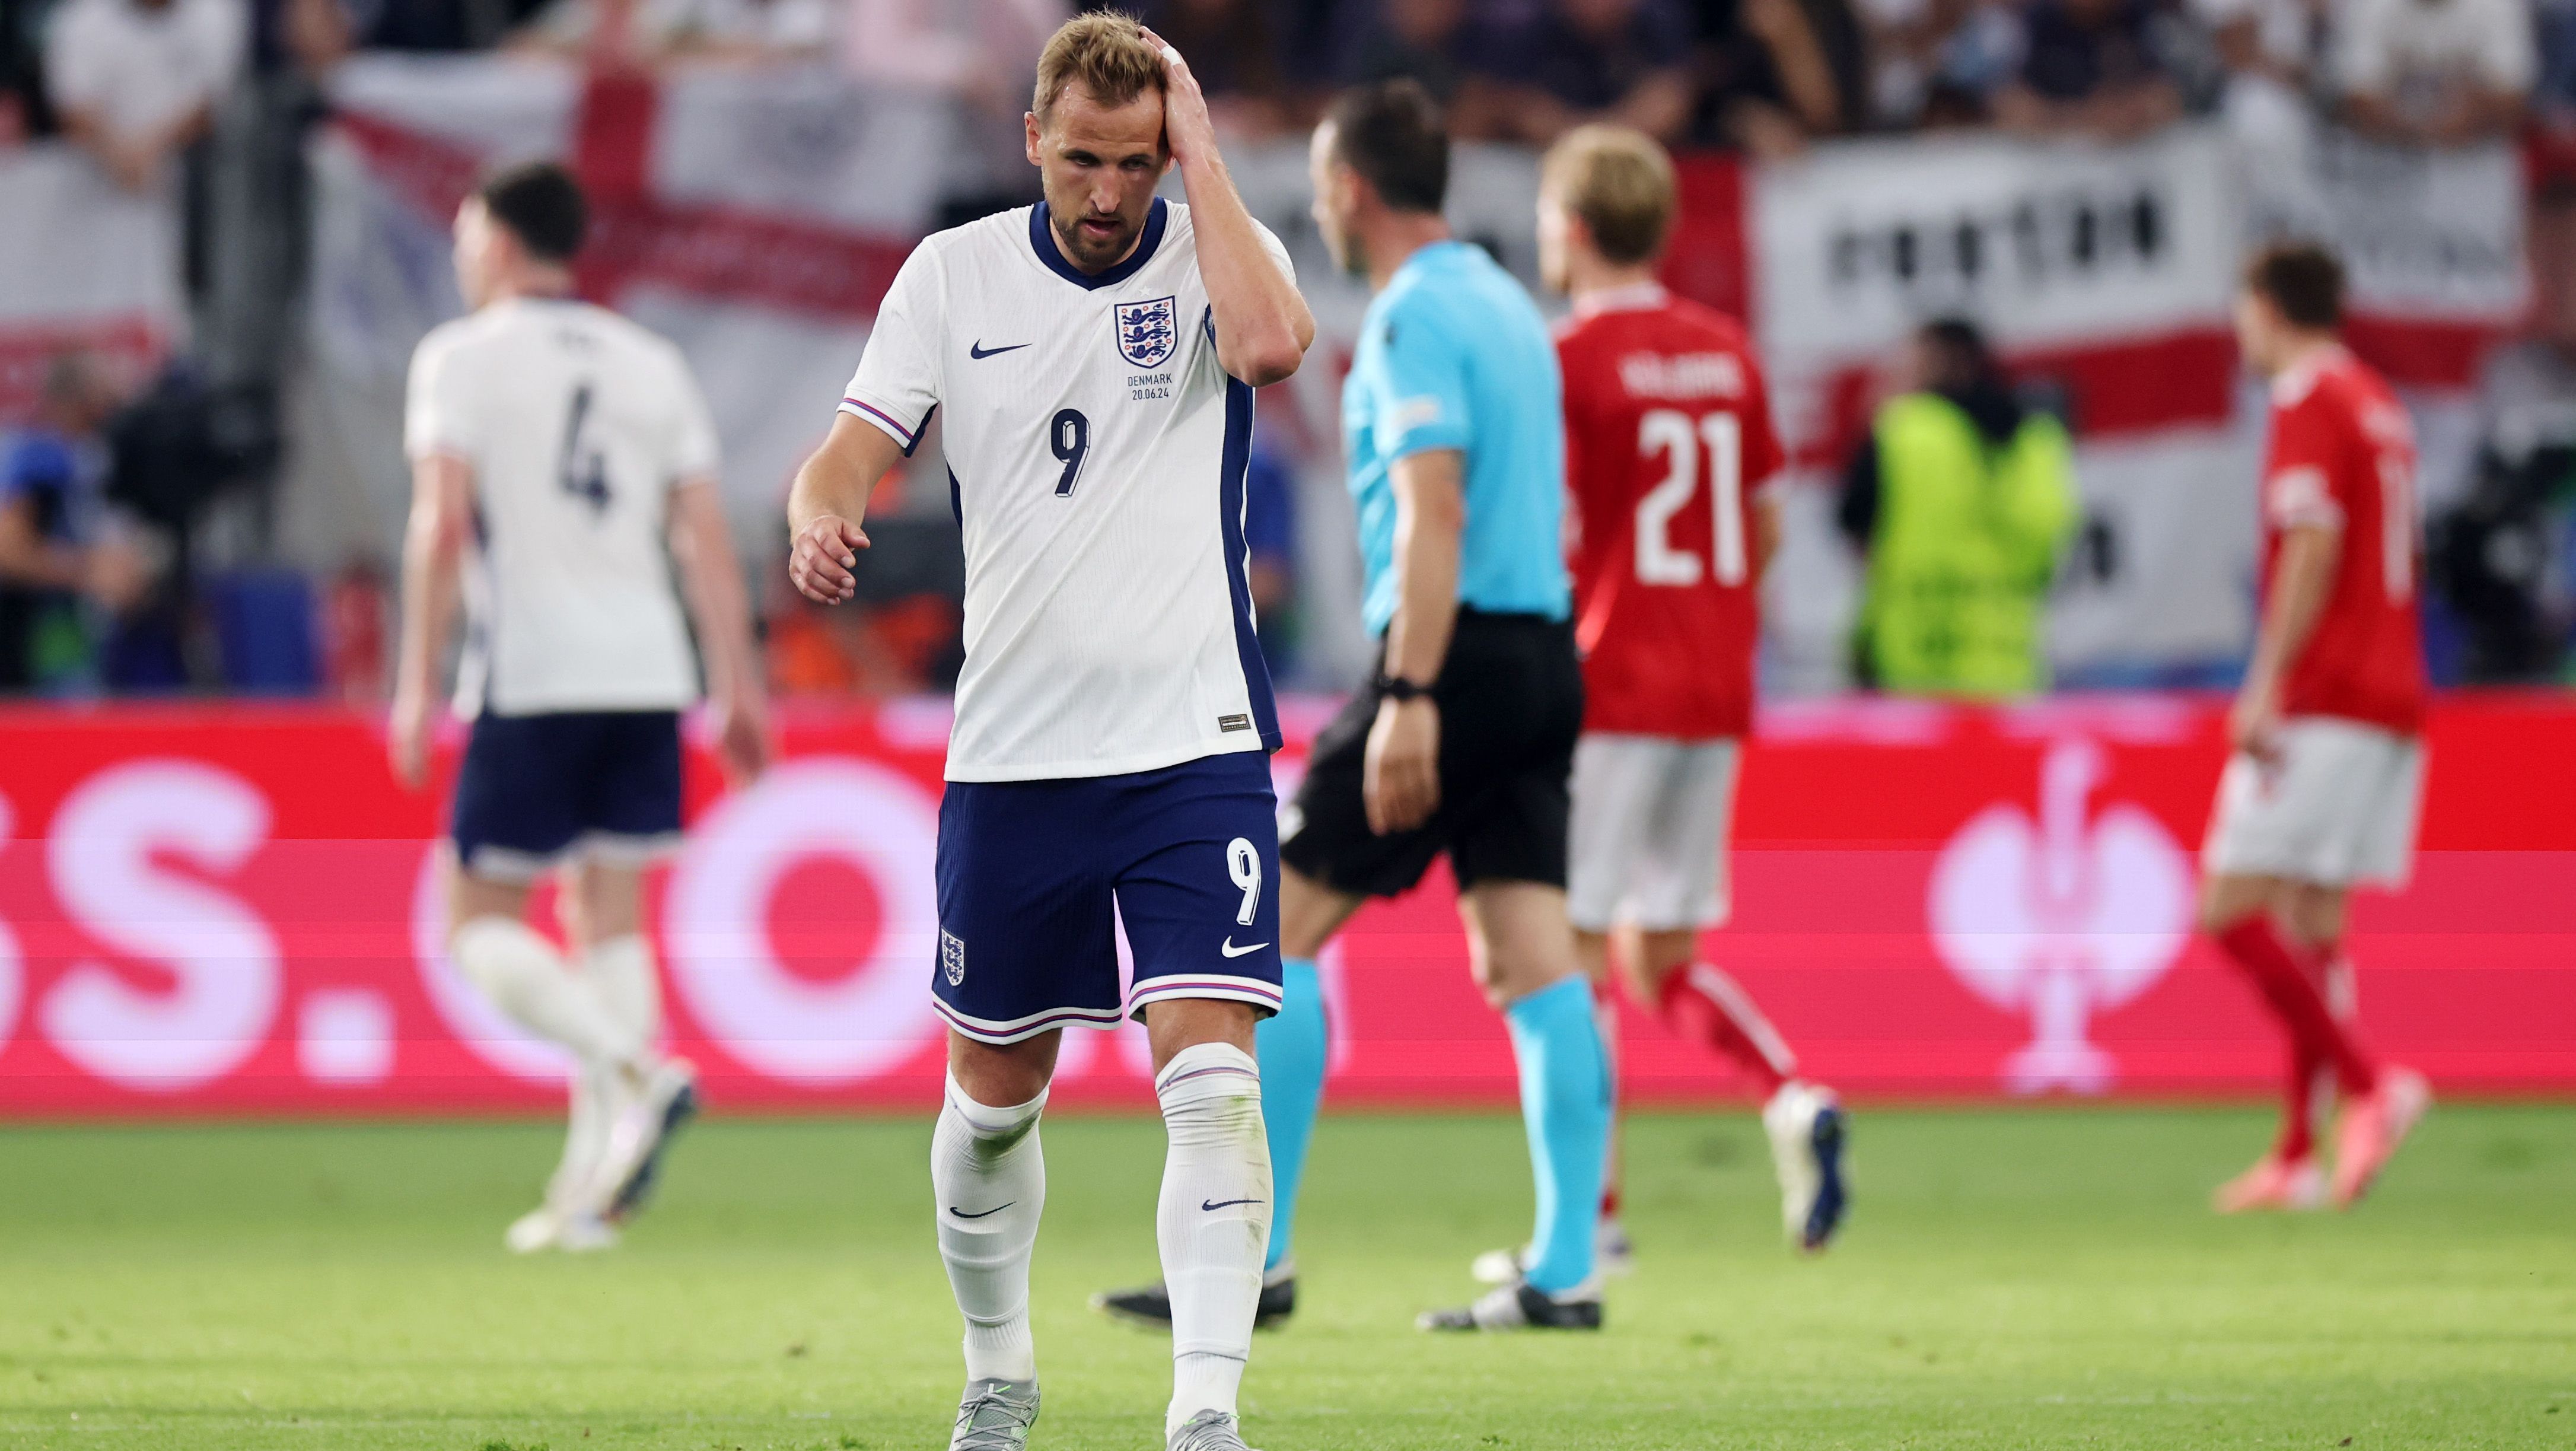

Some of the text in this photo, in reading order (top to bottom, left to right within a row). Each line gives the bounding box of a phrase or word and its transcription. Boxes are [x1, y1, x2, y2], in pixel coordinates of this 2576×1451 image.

[1128, 373, 1172, 387] DENMARK
[1132, 387, 1169, 400] 20.06.24
[556, 380, 613, 511] 4
[1050, 408, 1091, 498] 9
[1634, 409, 1749, 586] 21
[1226, 836, 1262, 926] 9
